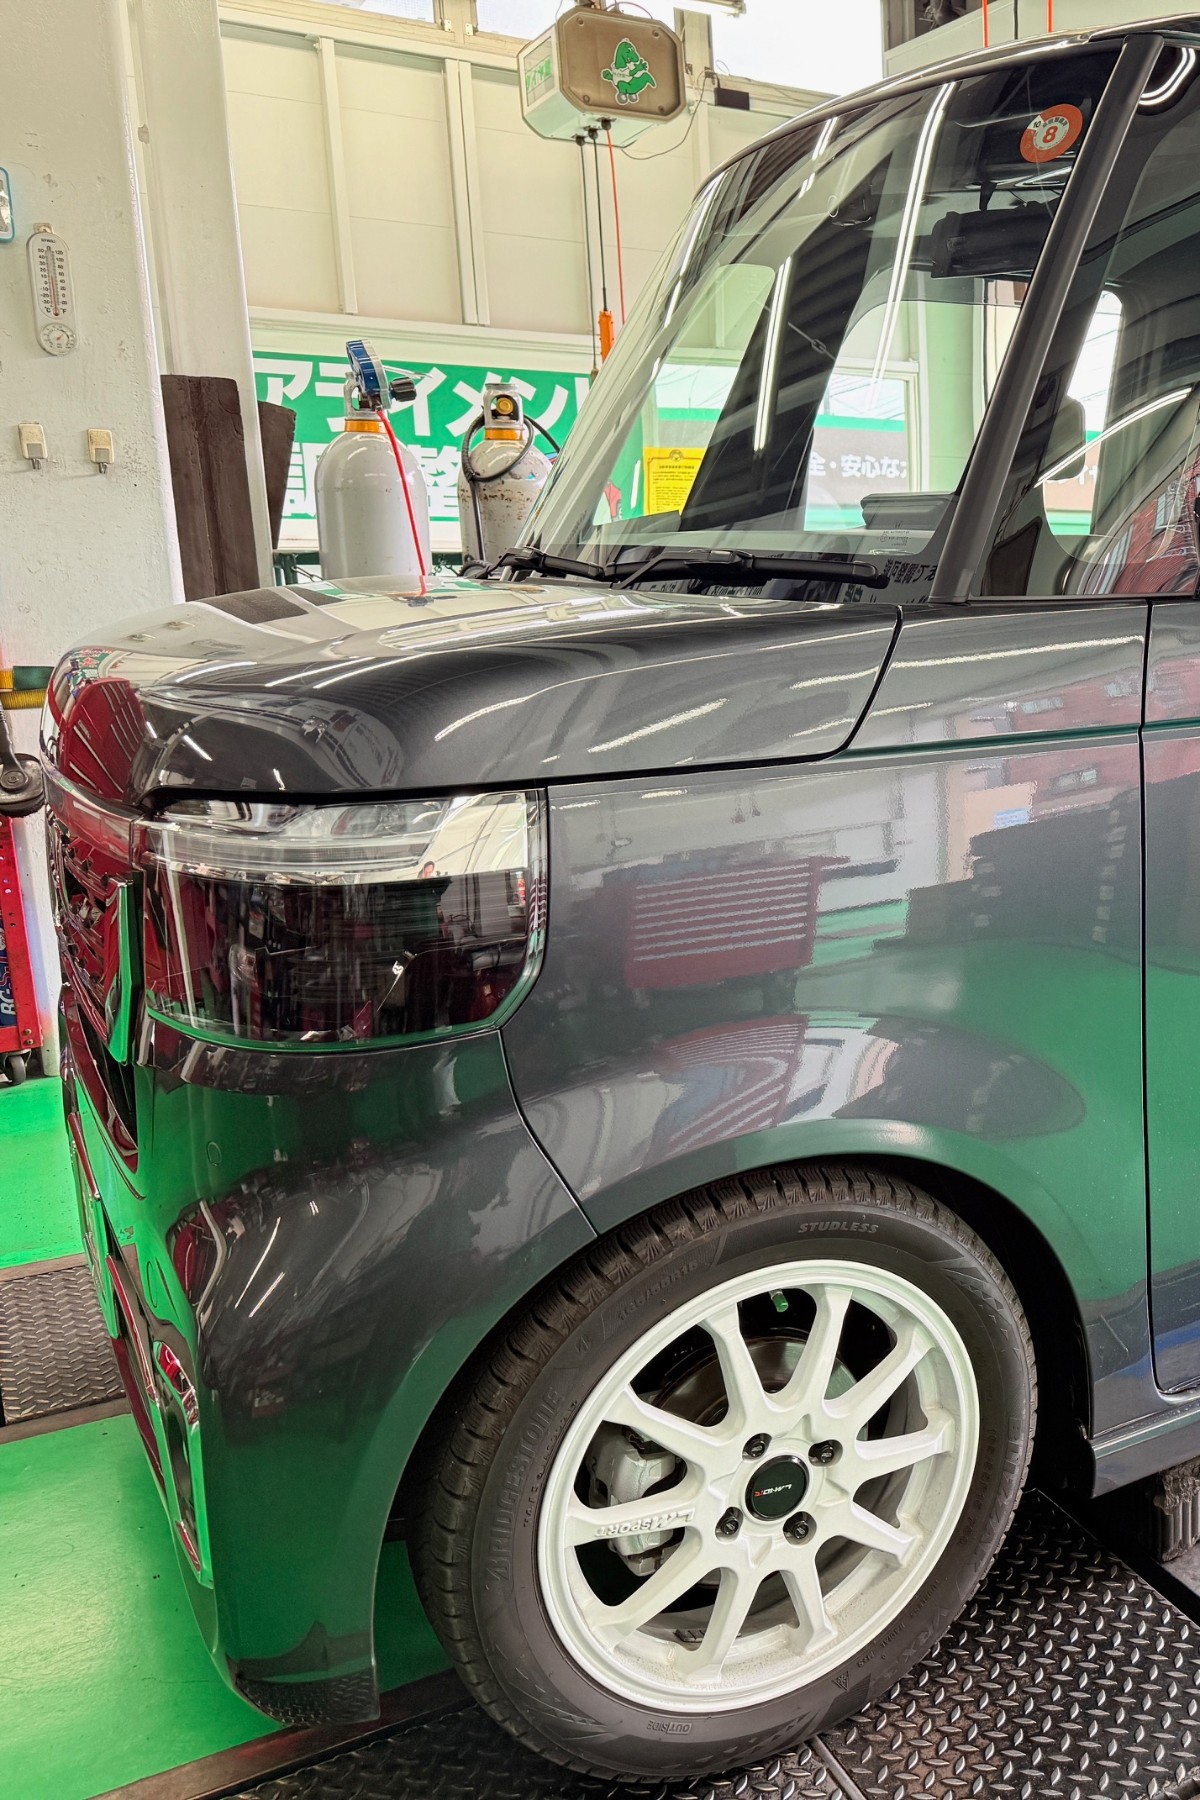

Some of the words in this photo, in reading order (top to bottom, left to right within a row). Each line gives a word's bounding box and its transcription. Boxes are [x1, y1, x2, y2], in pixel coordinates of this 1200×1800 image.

[1043, 126, 1058, 143] 8
[797, 1221, 879, 1234] STUDLESS
[486, 1387, 565, 1582] BRIDGESTONE
[647, 1719, 691, 1733] OUTSIDE
